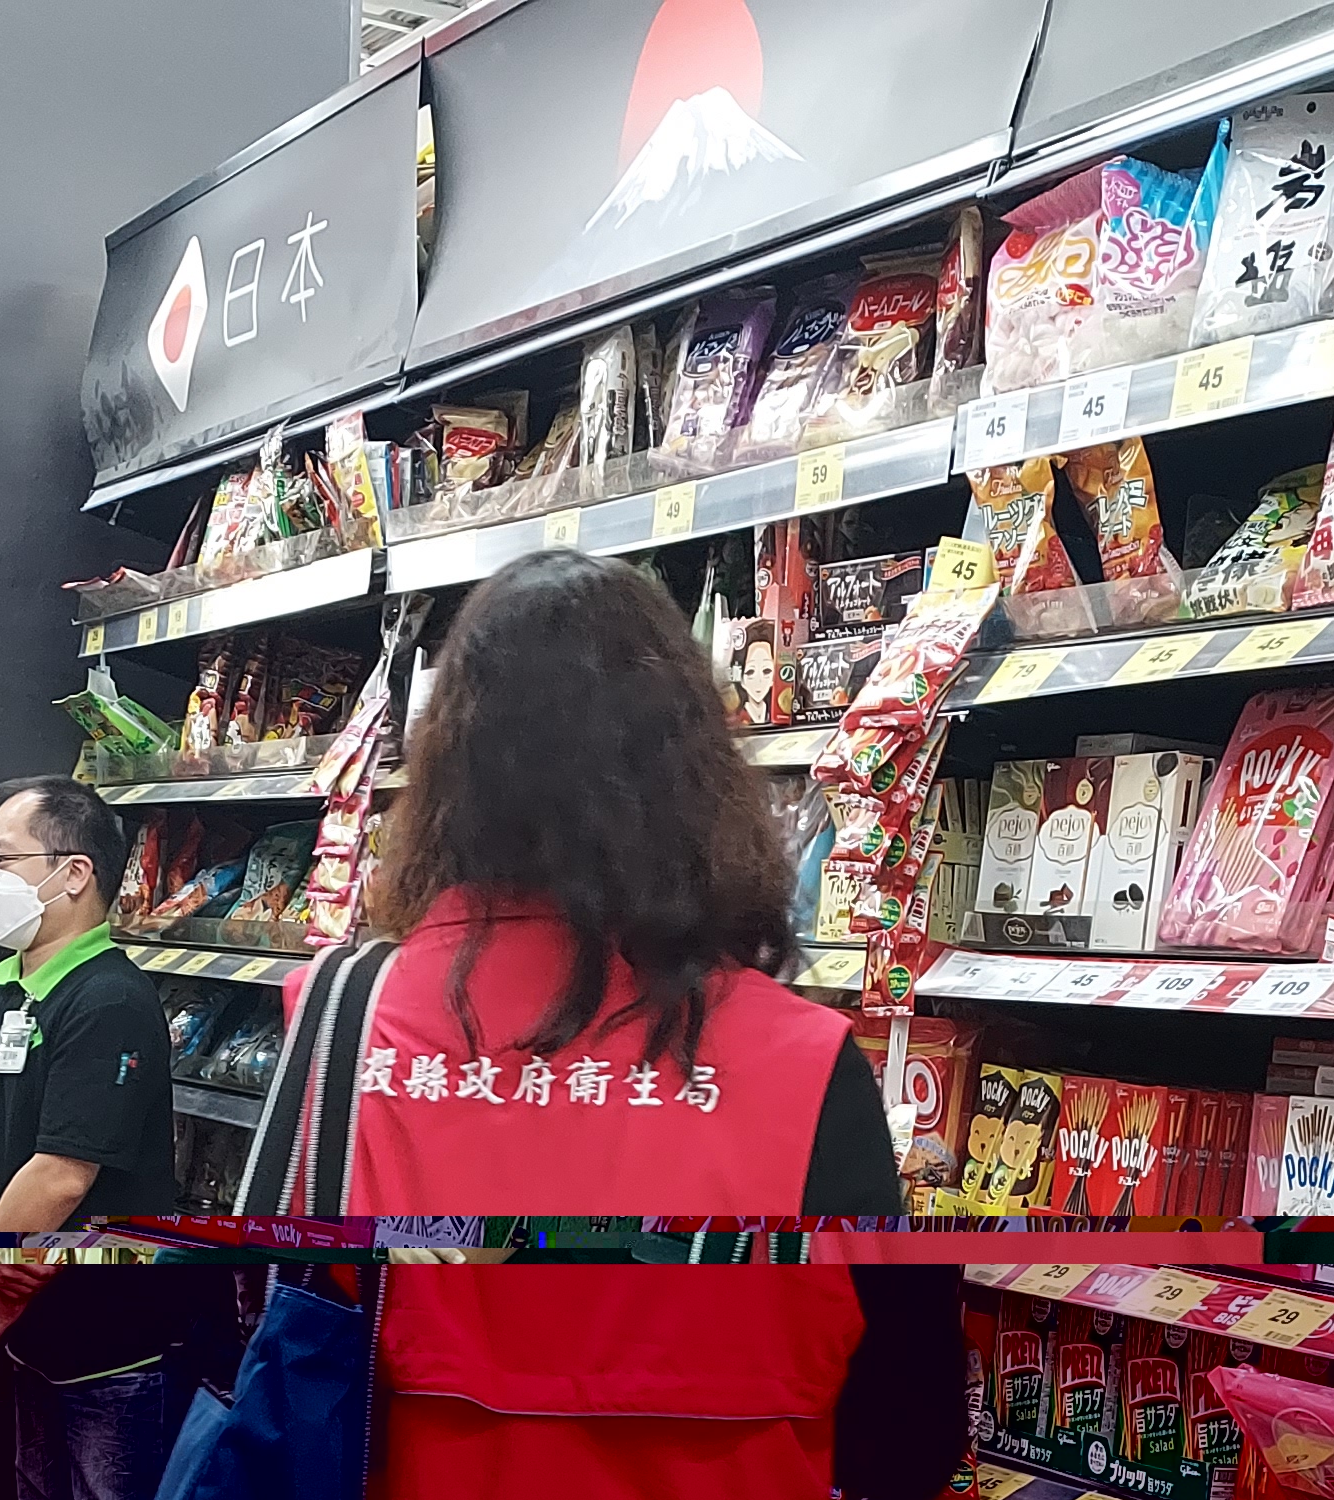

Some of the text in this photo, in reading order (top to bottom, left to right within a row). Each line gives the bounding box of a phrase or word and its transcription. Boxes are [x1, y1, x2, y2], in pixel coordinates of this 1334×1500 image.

[222, 210, 329, 348] 日本
[1198, 366, 1223, 391] 45
[1083, 395, 1105, 418] 45
[985, 415, 1007, 438] 45
[811, 465, 828, 485] 59
[666, 501, 681, 520] 49
[951, 559, 978, 581] 45
[827, 572, 882, 599] アルフォート
[1259, 637, 1288, 653] 45
[801, 651, 850, 677] アルフォート
[1148, 648, 1177, 665] 45
[1014, 663, 1039, 680] 79
[998, 812, 1034, 840] pejoy
[1051, 812, 1087, 840] pejoy
[1119, 811, 1156, 839] pejoy
[1069, 973, 1101, 988] 45
[1154, 975, 1196, 992] 109
[1268, 979, 1310, 996] 109
[1045, 1264, 1069, 1280] 29
[1155, 1285, 1184, 1301] 29
[1272, 1308, 1301, 1325] 29
[1133, 1359, 1178, 1395] PRETZ
[1135, 1403, 1179, 1433] 旨サラダ
[1149, 1437, 1175, 1454] Salad
[978, 1476, 999, 1492] 45
[1110, 1459, 1146, 1490] プリッツ
